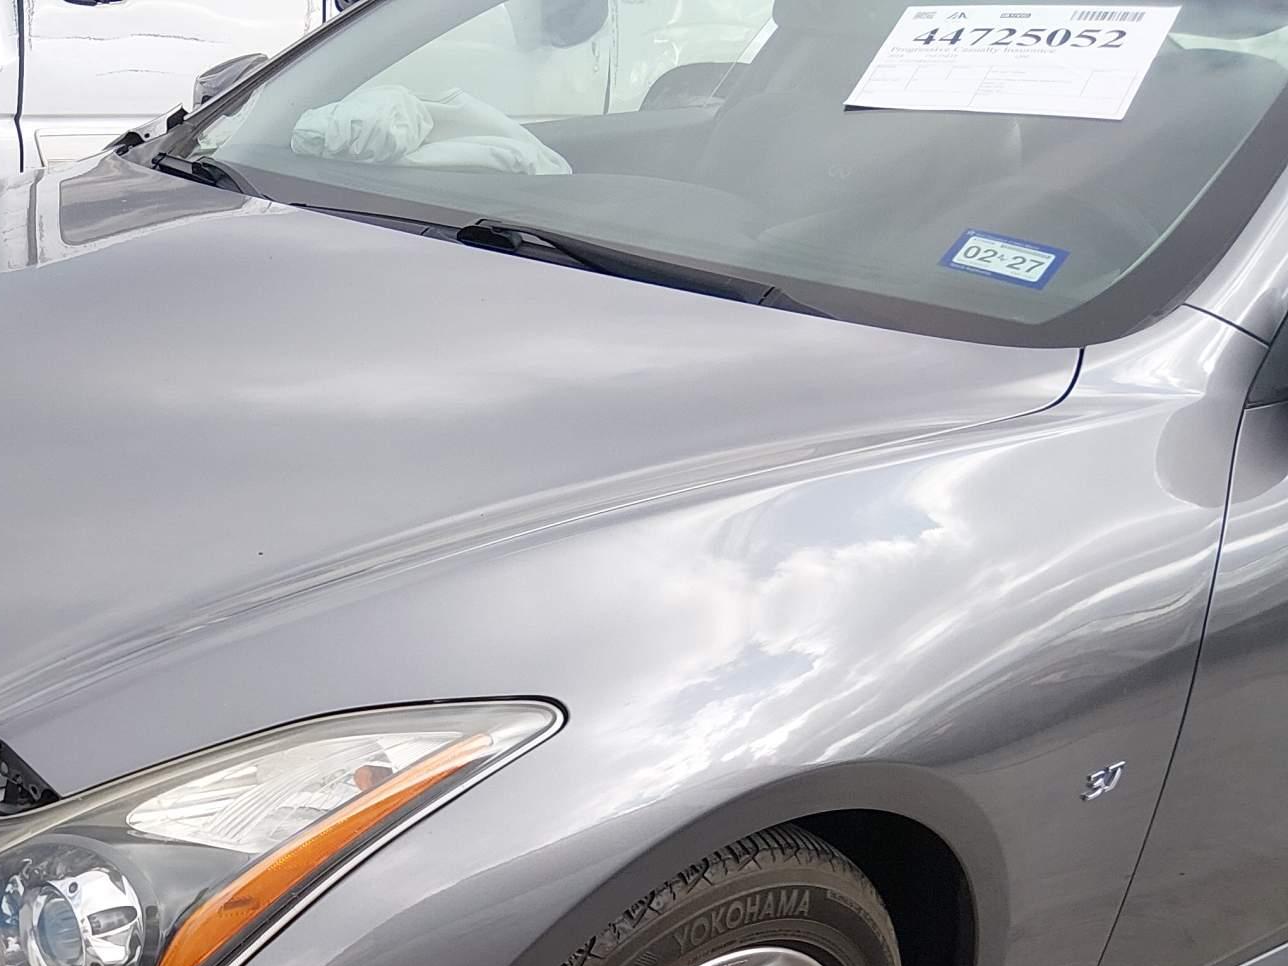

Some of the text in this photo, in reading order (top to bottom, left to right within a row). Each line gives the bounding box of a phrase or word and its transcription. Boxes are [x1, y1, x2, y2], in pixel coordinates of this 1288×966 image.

[912, 27, 1128, 48] 44725052
[963, 245, 998, 264] 02
[1005, 255, 1046, 274] 27
[673, 888, 811, 955] YOKOHAMA
